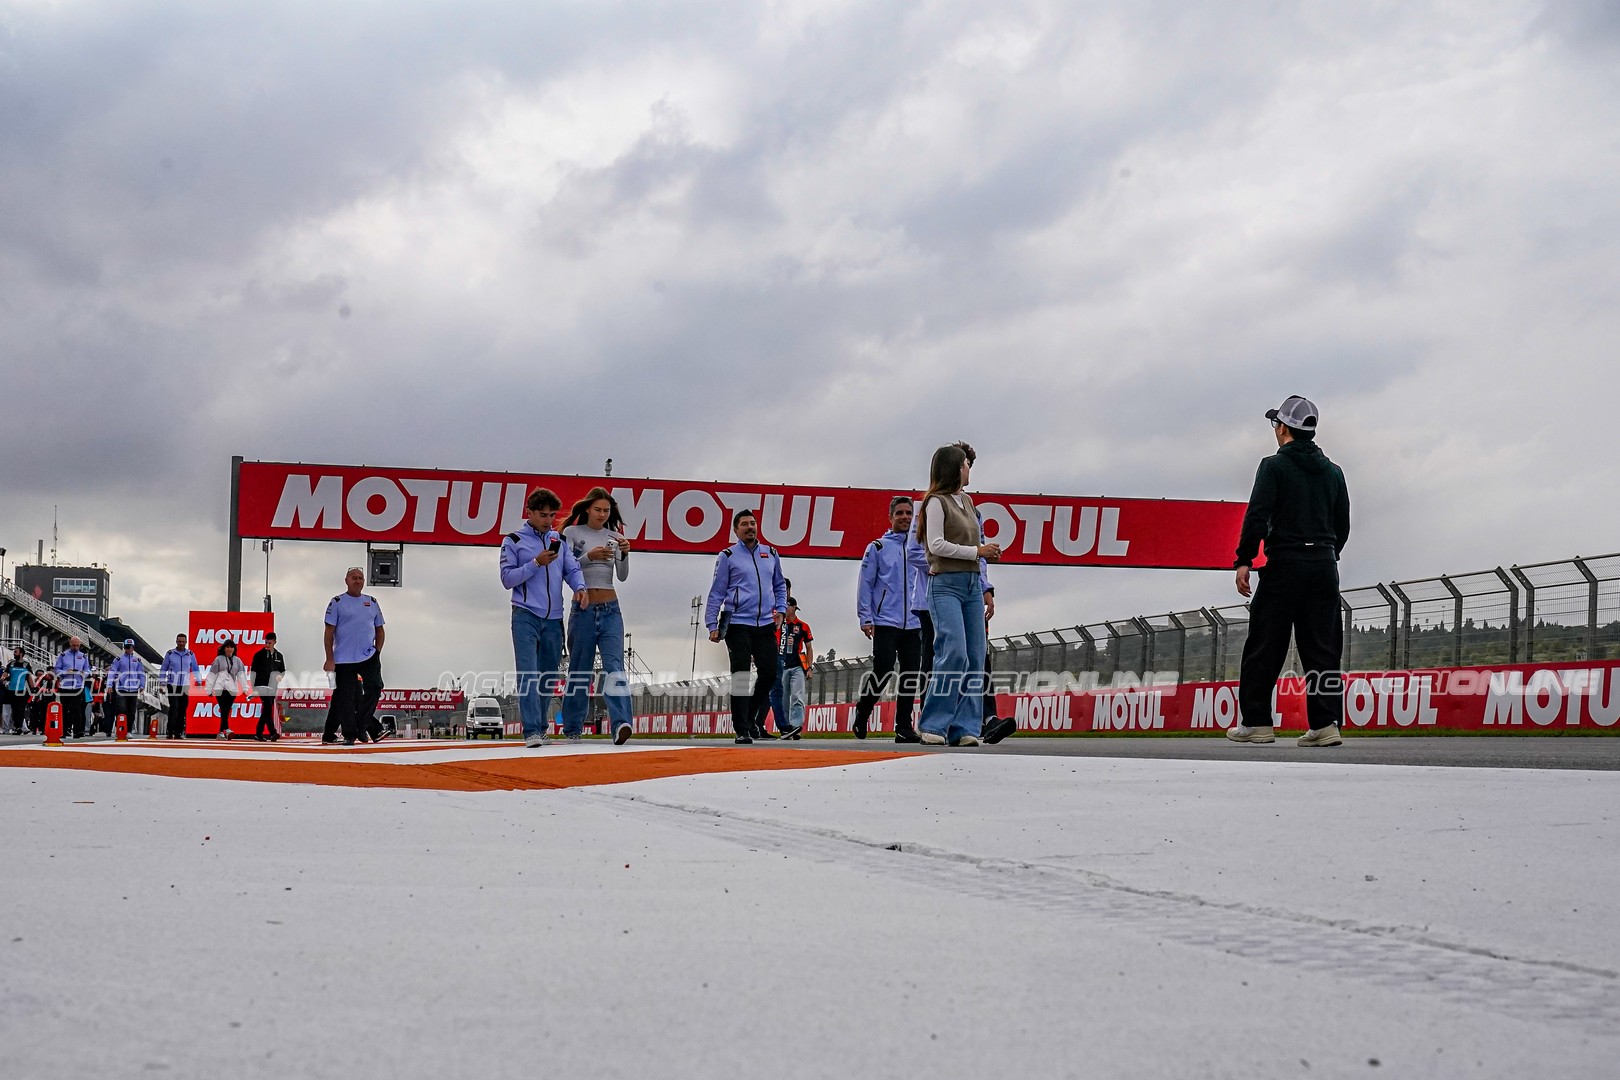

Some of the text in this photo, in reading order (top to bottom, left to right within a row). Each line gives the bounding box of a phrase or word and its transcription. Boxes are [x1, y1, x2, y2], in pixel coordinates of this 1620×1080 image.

[271, 474, 1130, 557] MOTUL MOTUL OTUL
[195, 629, 266, 645] MOTUL
[282, 690, 452, 702] MOTUL OTUL MOTUL
[693, 714, 711, 733] MOTUL
[715, 713, 736, 734] MOTU
[808, 706, 838, 731] MOTUL
[846, 705, 883, 732] MUL
[1015, 696, 1073, 731] MOTUL
[1092, 690, 1165, 730] MOTUL
[1190, 685, 1283, 729] MOL
[1342, 675, 1438, 727] OTUL
